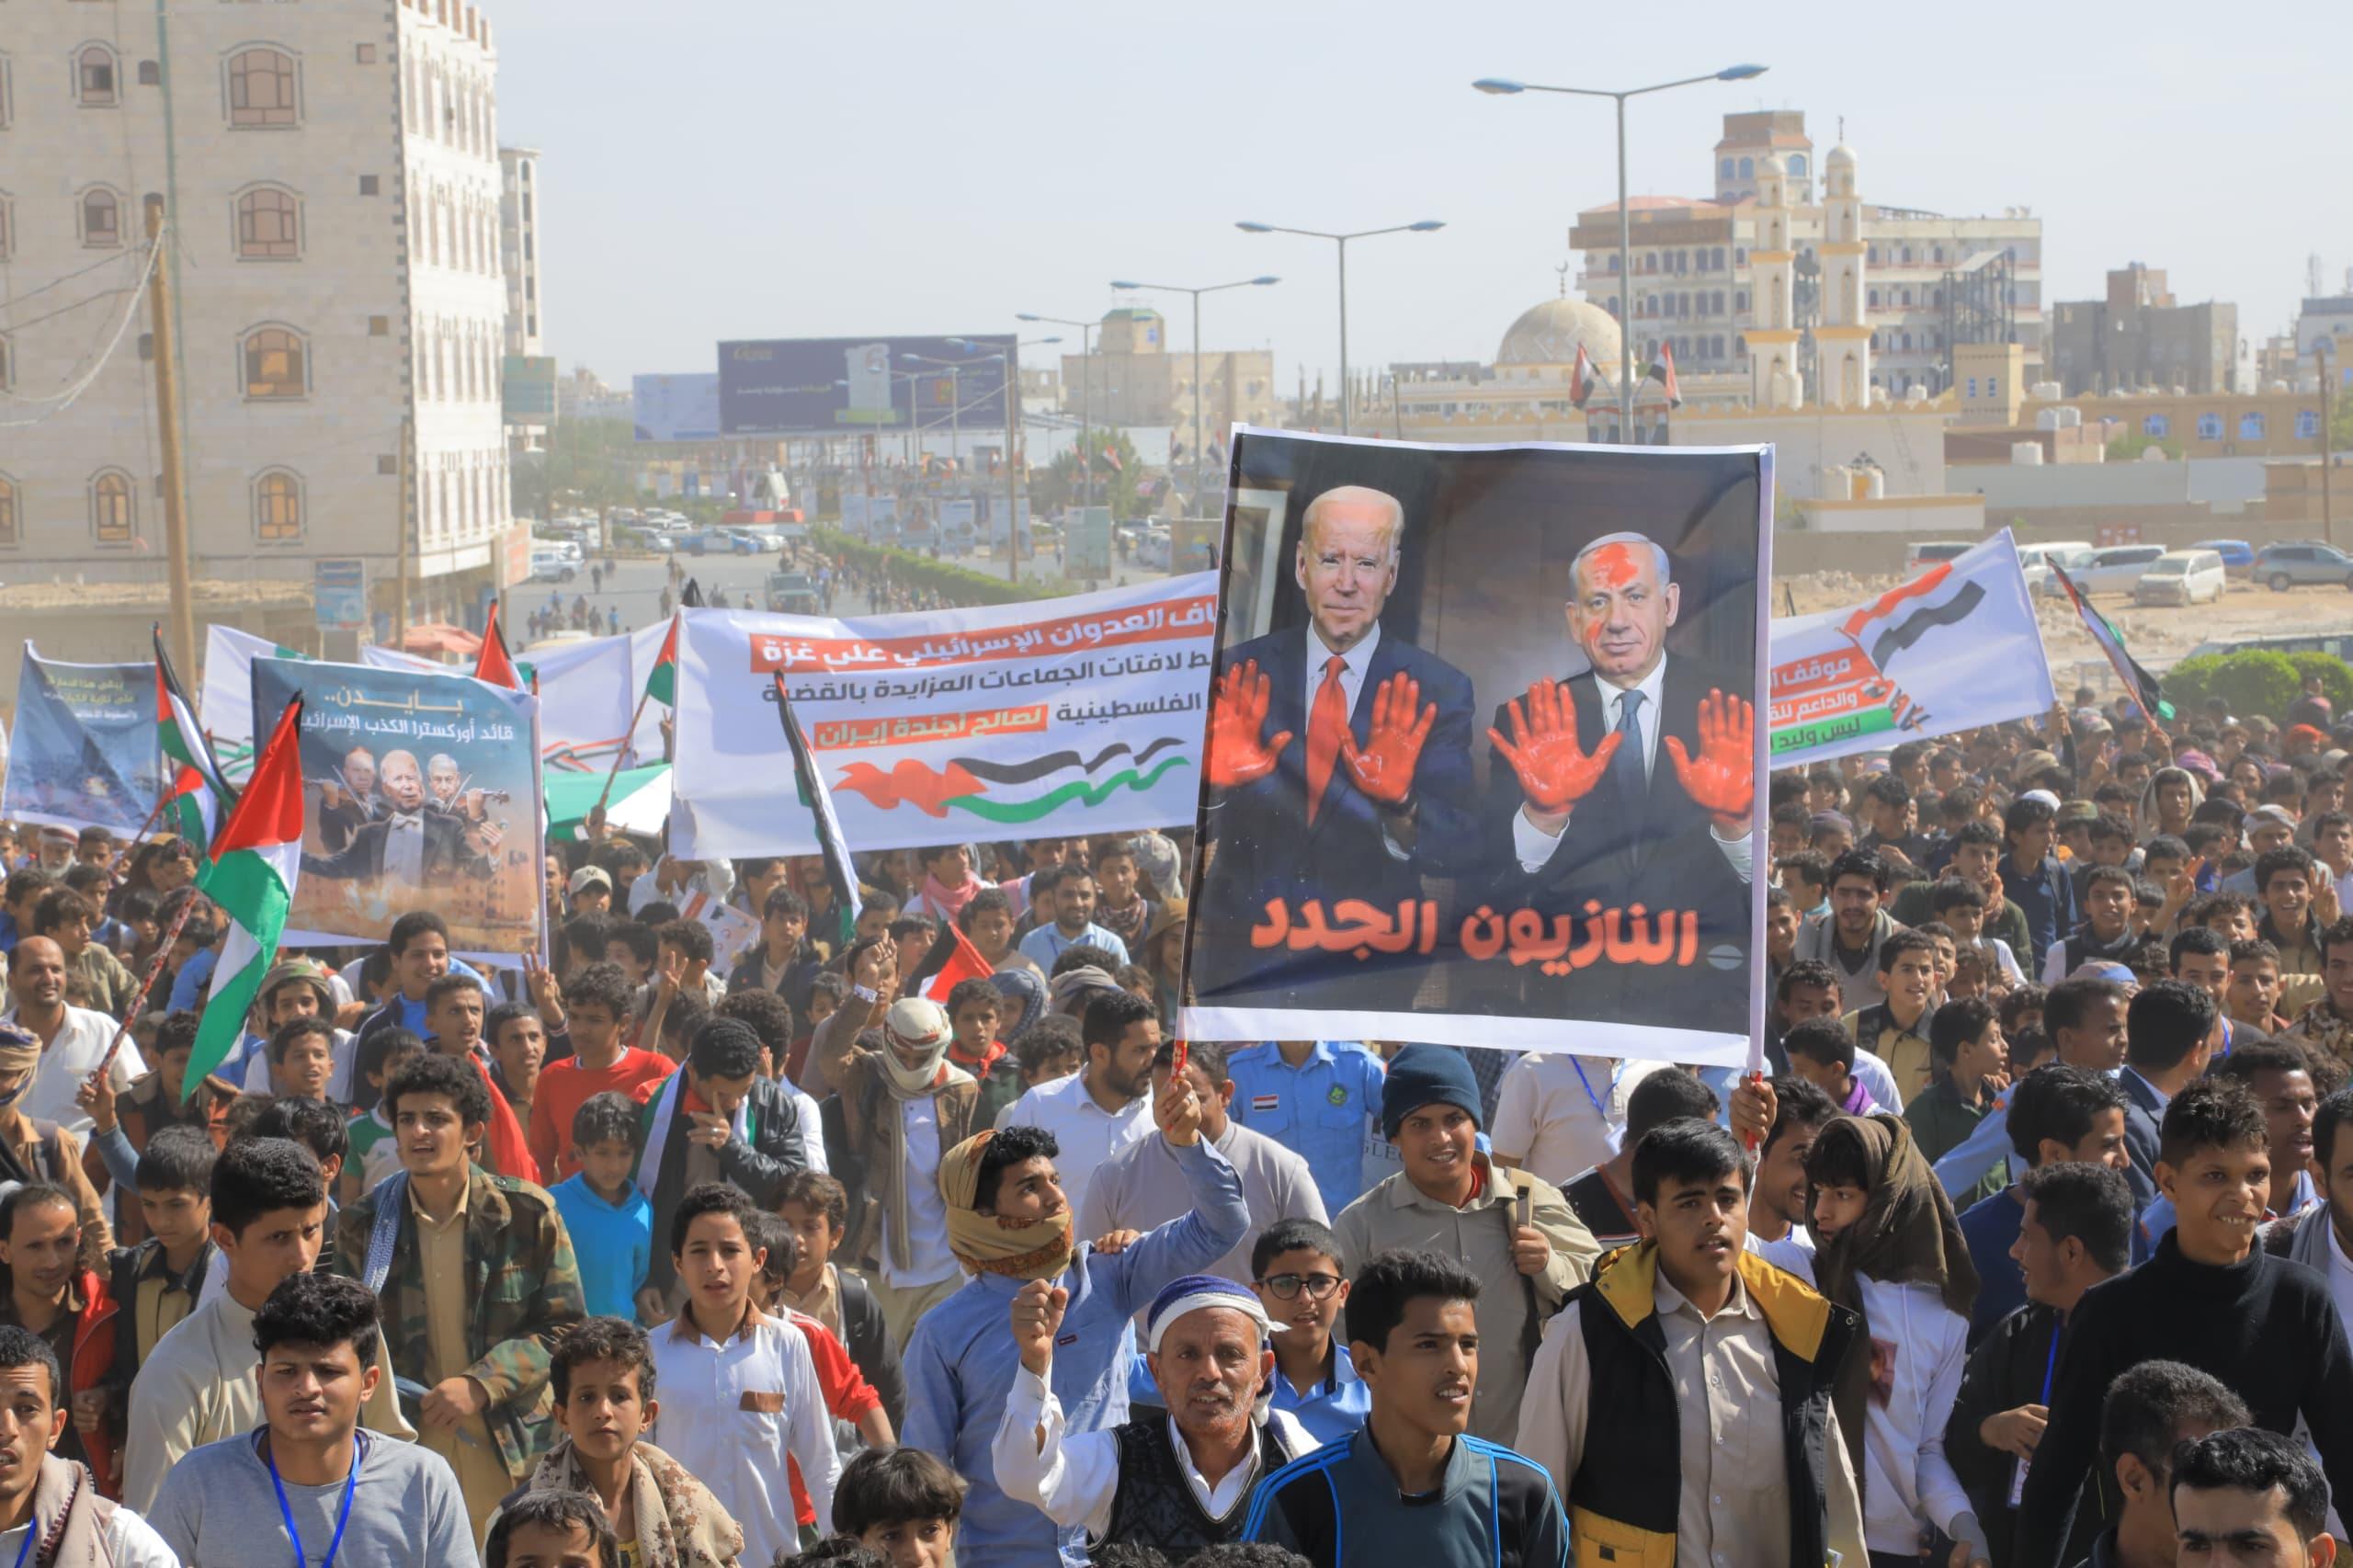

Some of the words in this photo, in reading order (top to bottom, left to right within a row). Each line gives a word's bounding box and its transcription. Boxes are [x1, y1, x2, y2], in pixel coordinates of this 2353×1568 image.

[1169, 602, 1216, 625] اف
[1050, 608, 1165, 647] العدوان
[763, 639, 816, 667] غزة
[824, 643, 887, 665] على
[893, 629, 1043, 667] الإسرائيلي
[979, 661, 1094, 689] الجماعات
[1099, 652, 1182, 677] لافتات
[1782, 657, 1851, 685] موقف
[762, 682, 867, 704] بالقضة
[874, 675, 972, 699] المزايدة
[1056, 693, 1201, 725] الفلسطينية
[1796, 690, 1858, 721] والداعم
[278, 710, 360, 736] الإسرائي
[364, 719, 409, 736] الكذب
[412, 718, 475, 743] أوركسترا
[480, 723, 514, 741] قائد
[820, 720, 888, 746] إيران
[893, 713, 966, 737] أجندة
[970, 707, 1041, 735] لصالح
[1821, 717, 1860, 742] ليس
[1779, 730, 1817, 750] وليد
[1251, 898, 1438, 961] الجدد
[1461, 899, 1697, 976] النازيون
